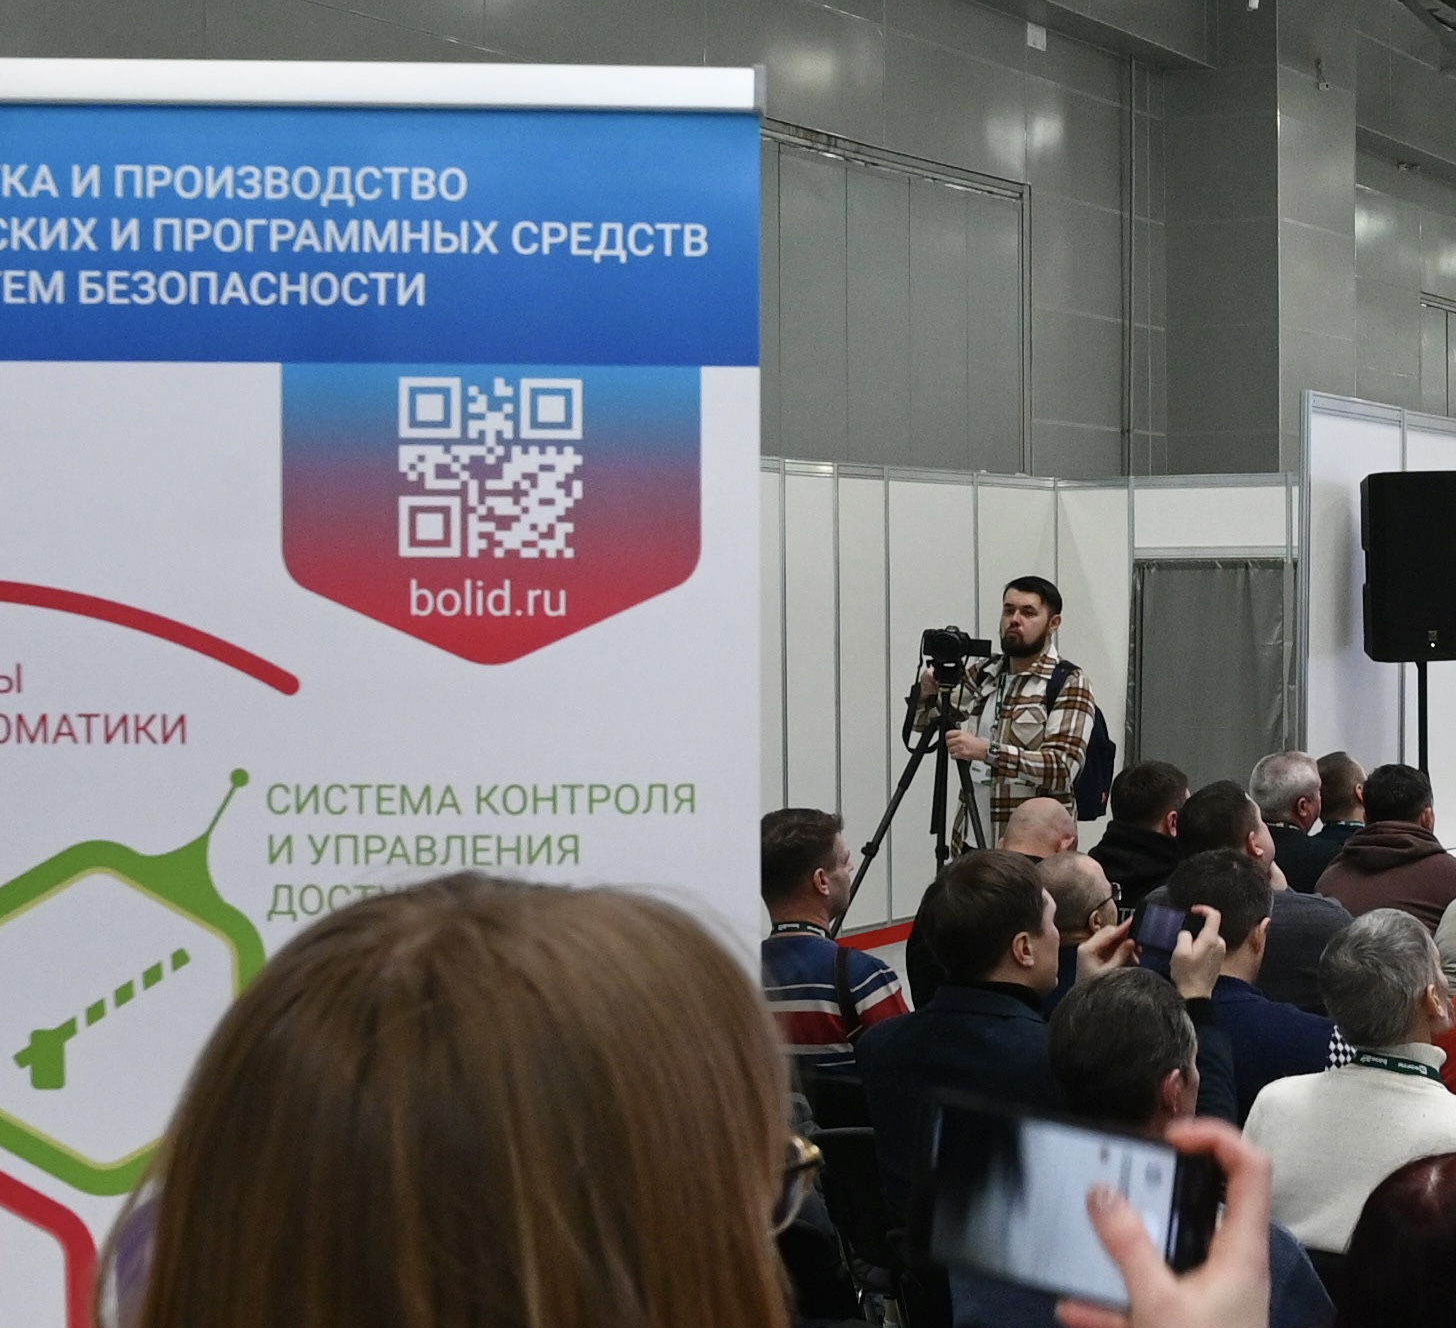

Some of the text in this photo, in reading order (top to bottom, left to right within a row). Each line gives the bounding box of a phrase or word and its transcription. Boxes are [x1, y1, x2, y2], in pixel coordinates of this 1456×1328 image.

[71, 167, 100, 199] И
[115, 166, 468, 207] ПРОИЗВОДСТВО
[112, 220, 140, 252] И
[153, 219, 498, 255] ПРОГРАММНЫХ
[511, 222, 709, 262] СРЕДСТВ
[79, 272, 425, 307] БЕЗОПАСНОСТИ
[410, 580, 566, 618] bolid.ru
[266, 784, 696, 816] СИСТЕМА КОНТРОЛЯ
[268, 834, 579, 865] И УПРАВЛЕНИЯ
